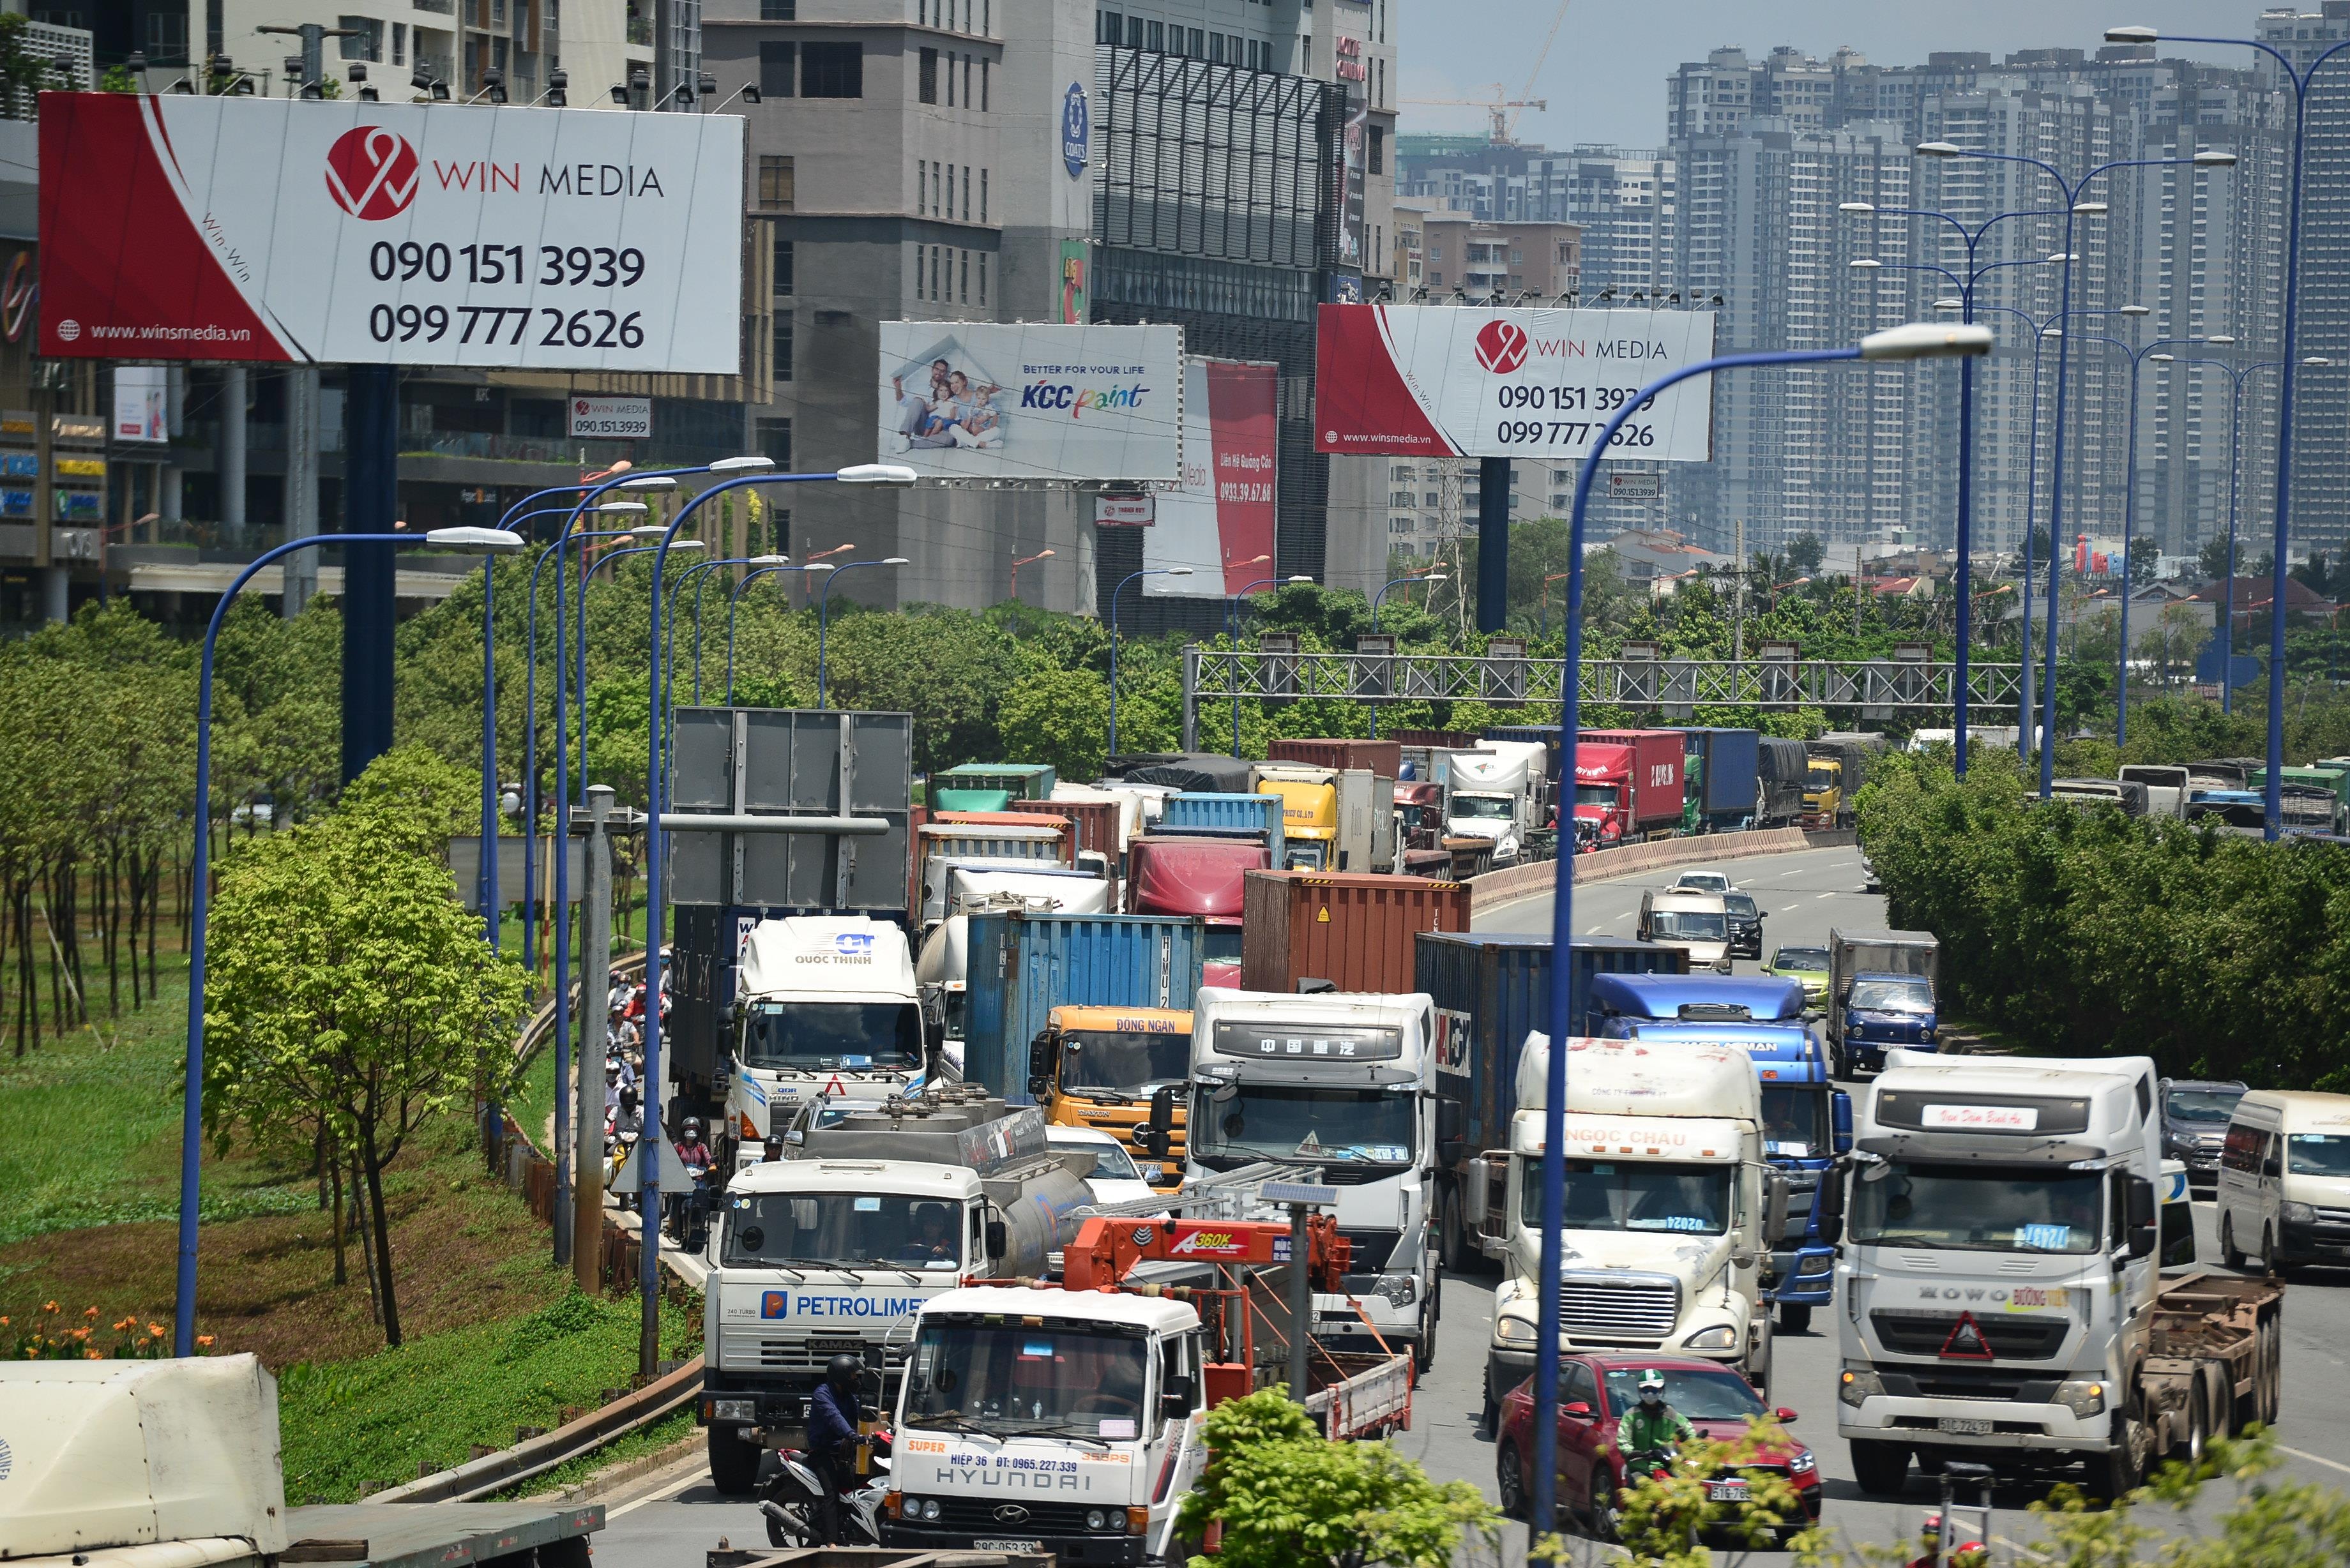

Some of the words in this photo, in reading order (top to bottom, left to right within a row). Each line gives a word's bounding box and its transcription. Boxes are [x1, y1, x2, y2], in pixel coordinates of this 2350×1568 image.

[1066, 141, 1086, 160] COATS
[432, 160, 520, 193] WIN
[539, 163, 665, 198] MEDIA
[202, 211, 251, 283] Win-Win
[370, 241, 452, 282] 090
[459, 244, 524, 285] 151
[539, 245, 646, 288] 3939
[90, 324, 250, 341] www.winsmedia.vn
[370, 303, 450, 343] 099
[457, 306, 533, 345] 777
[538, 307, 645, 349] 2626
[1536, 338, 1585, 358] WIN
[1595, 339, 1667, 359] MEDIA
[1023, 365, 1062, 374] BETTER
[1065, 365, 1086, 374] FOR
[1090, 366, 1120, 375] YOUR
[1123, 366, 1145, 375] LIFE
[1021, 379, 1073, 409] KCC
[1498, 385, 1545, 409] 090
[1549, 386, 1586, 410] 151
[591, 404, 614, 414] WIN
[616, 404, 648, 414] MEDIA
[575, 419, 647, 433] 090.151.3939
[1497, 421, 1543, 444] 099
[1547, 421, 1591, 445] 777
[1343, 433, 1431, 444] www.winsmedia.vn
[1260, 1038, 1356, 1055] 中国重汽
[797, 1296, 929, 1317] PETROLIME
[807, 1340, 863, 1349] KAMAZ
[908, 1440, 946, 1453] SUPER
[1082, 1451, 1130, 1463] 355PS
[951, 1452, 973, 1467] HIỆP
[975, 1455, 987, 1466] 36
[996, 1456, 1010, 1468] ĐT:
[1012, 1458, 1077, 1473] 0965.227.339
[936, 1468, 1091, 1491] HYUNDAI
